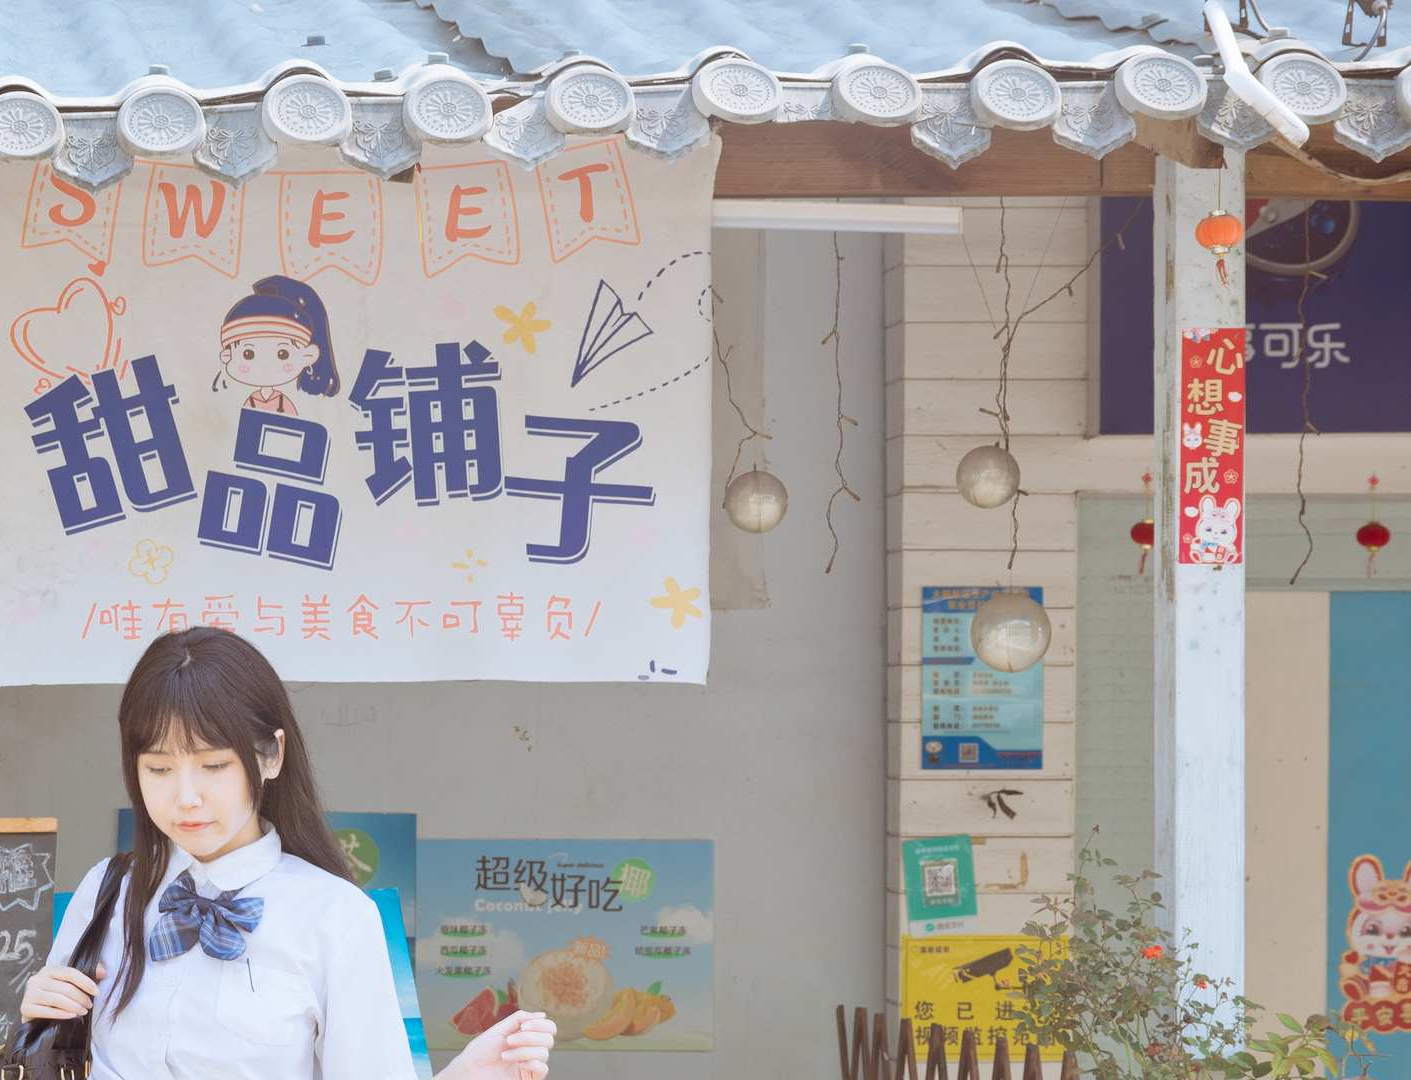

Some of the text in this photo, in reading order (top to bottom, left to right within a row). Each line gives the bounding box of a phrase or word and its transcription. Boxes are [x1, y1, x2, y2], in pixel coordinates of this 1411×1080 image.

[48, 163, 609, 248] SWEET
[1245, 323, 1350, 368] 可乐
[23, 339, 656, 571] 甜品铺子
[1184, 338, 1243, 493] 心想事成
